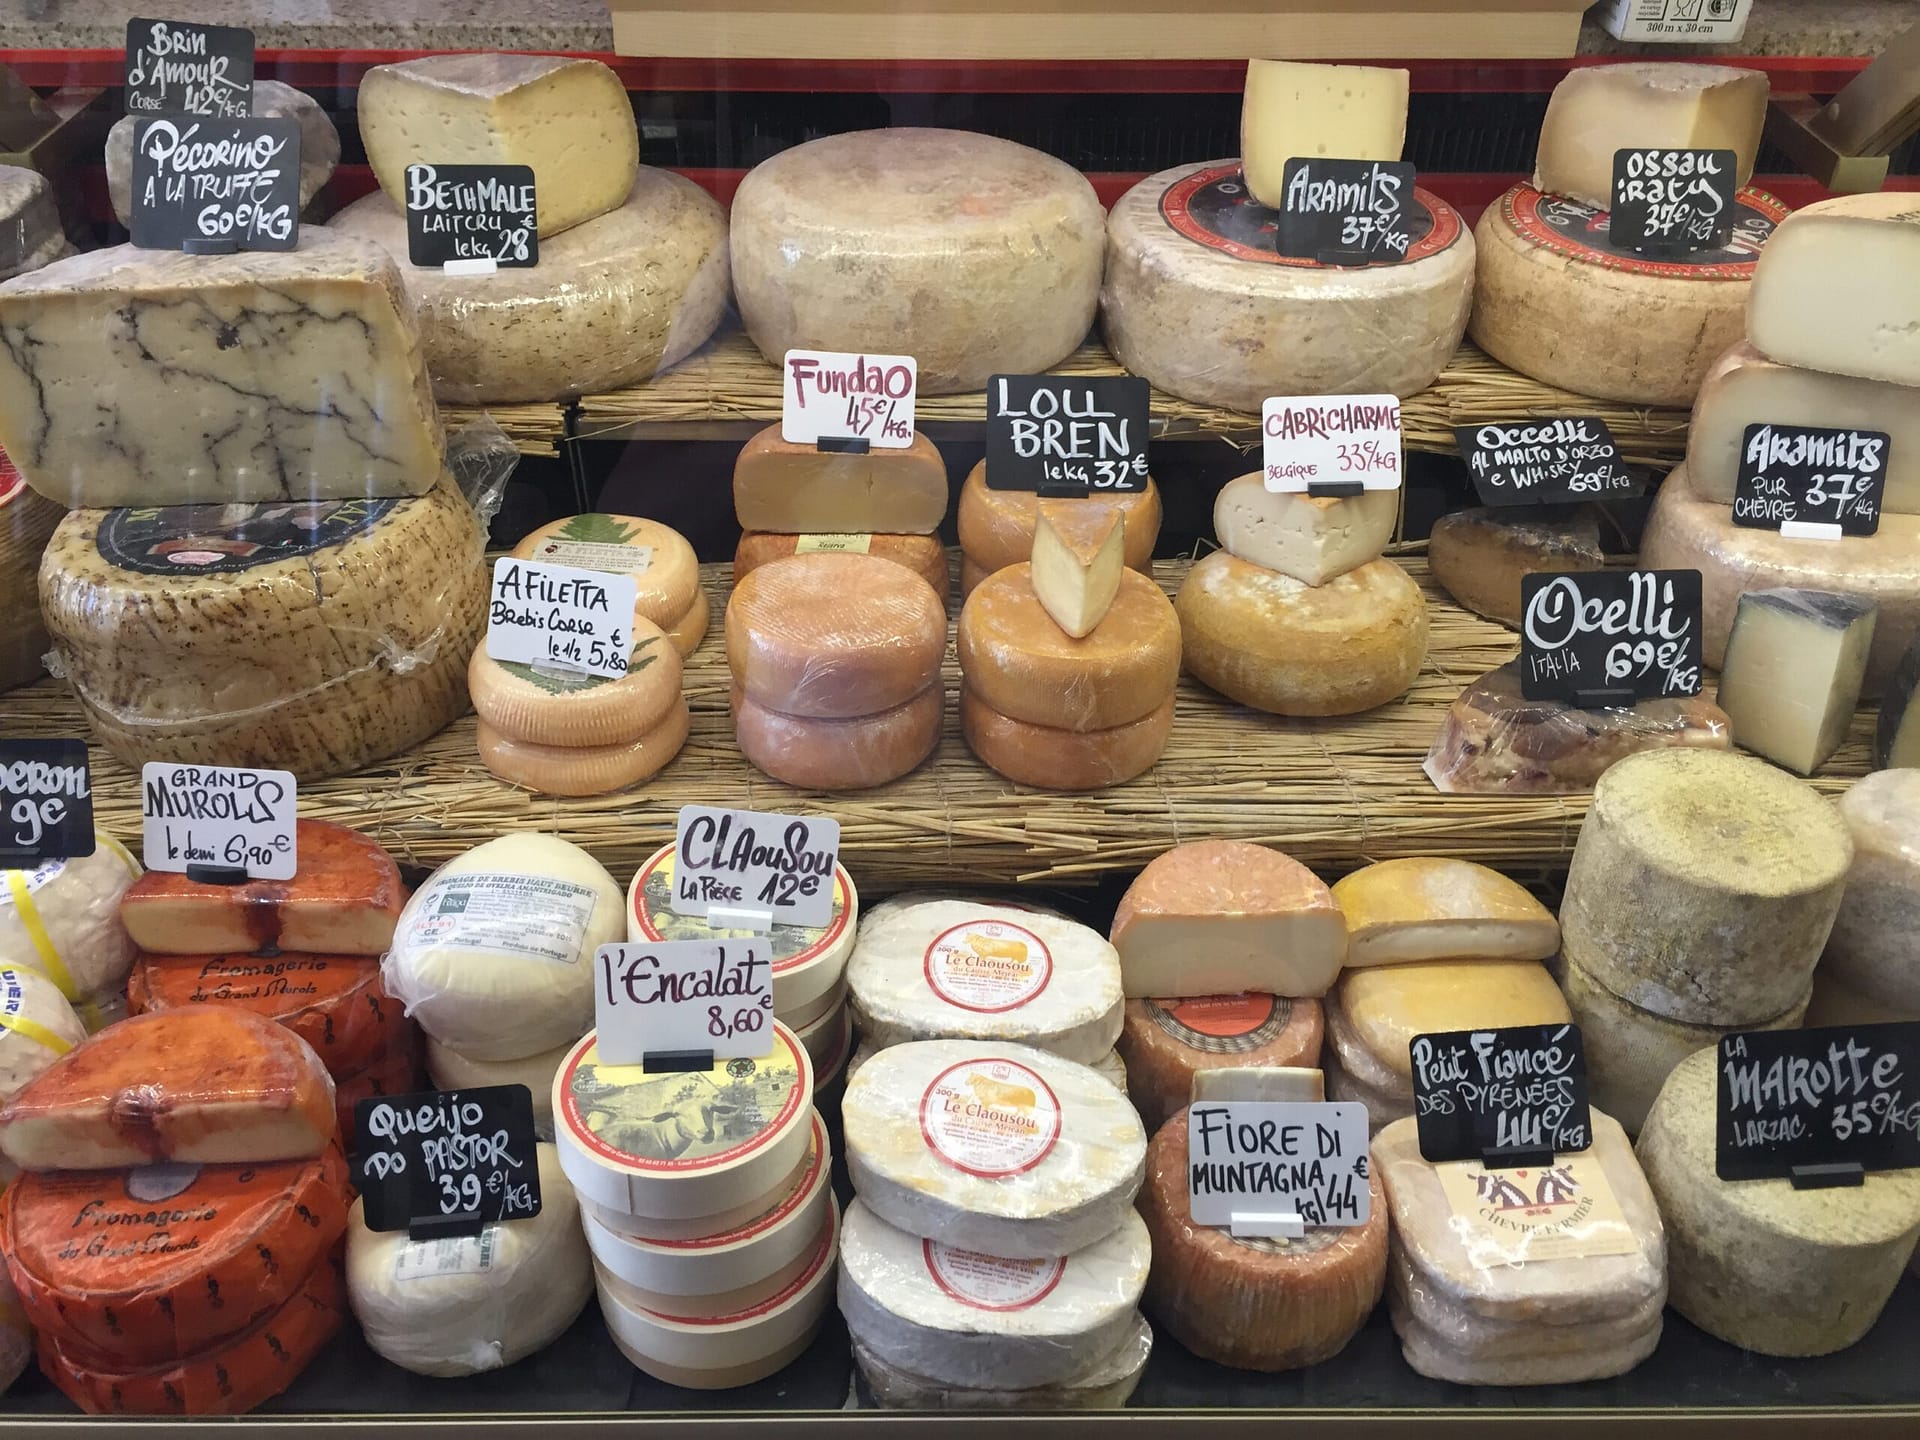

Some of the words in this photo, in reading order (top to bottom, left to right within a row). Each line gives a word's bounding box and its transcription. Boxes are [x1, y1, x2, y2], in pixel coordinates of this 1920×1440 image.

[1646, 22, 1664, 33] 300
[1664, 24, 1674, 33] m
[1676, 24, 1682, 33] x
[1685, 22, 1698, 33] 30
[1698, 24, 1714, 33] cm
[165, 174, 186, 207] LA
[191, 169, 281, 204] TRUFFE
[997, 378, 1116, 418] LOU
[1010, 418, 1130, 459] BREN
[1476, 420, 1599, 449] Occelli
[1471, 451, 1490, 477] AL
[1494, 445, 1550, 467] MALTO
[1751, 476, 1791, 496] PUR
[1525, 571, 1691, 649] Ocelli
[562, 638, 581, 661] 1/2
[171, 768, 258, 789] GRAND
[144, 776, 283, 824] MUROLS
[166, 825, 179, 860] le
[184, 830, 215, 861] demi
[554, 881, 592, 898] BEURRE
[680, 876, 697, 901] LA
[758, 873, 819, 906] 12€
[199, 958, 327, 980] Fromagerie
[945, 955, 961, 965] Le
[965, 956, 1029, 972] Claousou
[190, 986, 208, 1001] du
[214, 982, 260, 1000] Grand
[264, 977, 318, 996] Murols
[1725, 1035, 1748, 1058] LA
[1416, 1089, 1455, 1115] DES
[1456, 1076, 1575, 1114] PYRÉNÉES
[369, 1094, 483, 1146] Queijo
[943, 1100, 961, 1113] Le
[966, 1103, 1035, 1129] Claousou
[364, 1152, 406, 1180] DO
[422, 1129, 523, 1182] PASTOR
[1192, 1159, 1324, 1195] MUNTAGNA
[72, 1200, 218, 1228] Fromagerie
